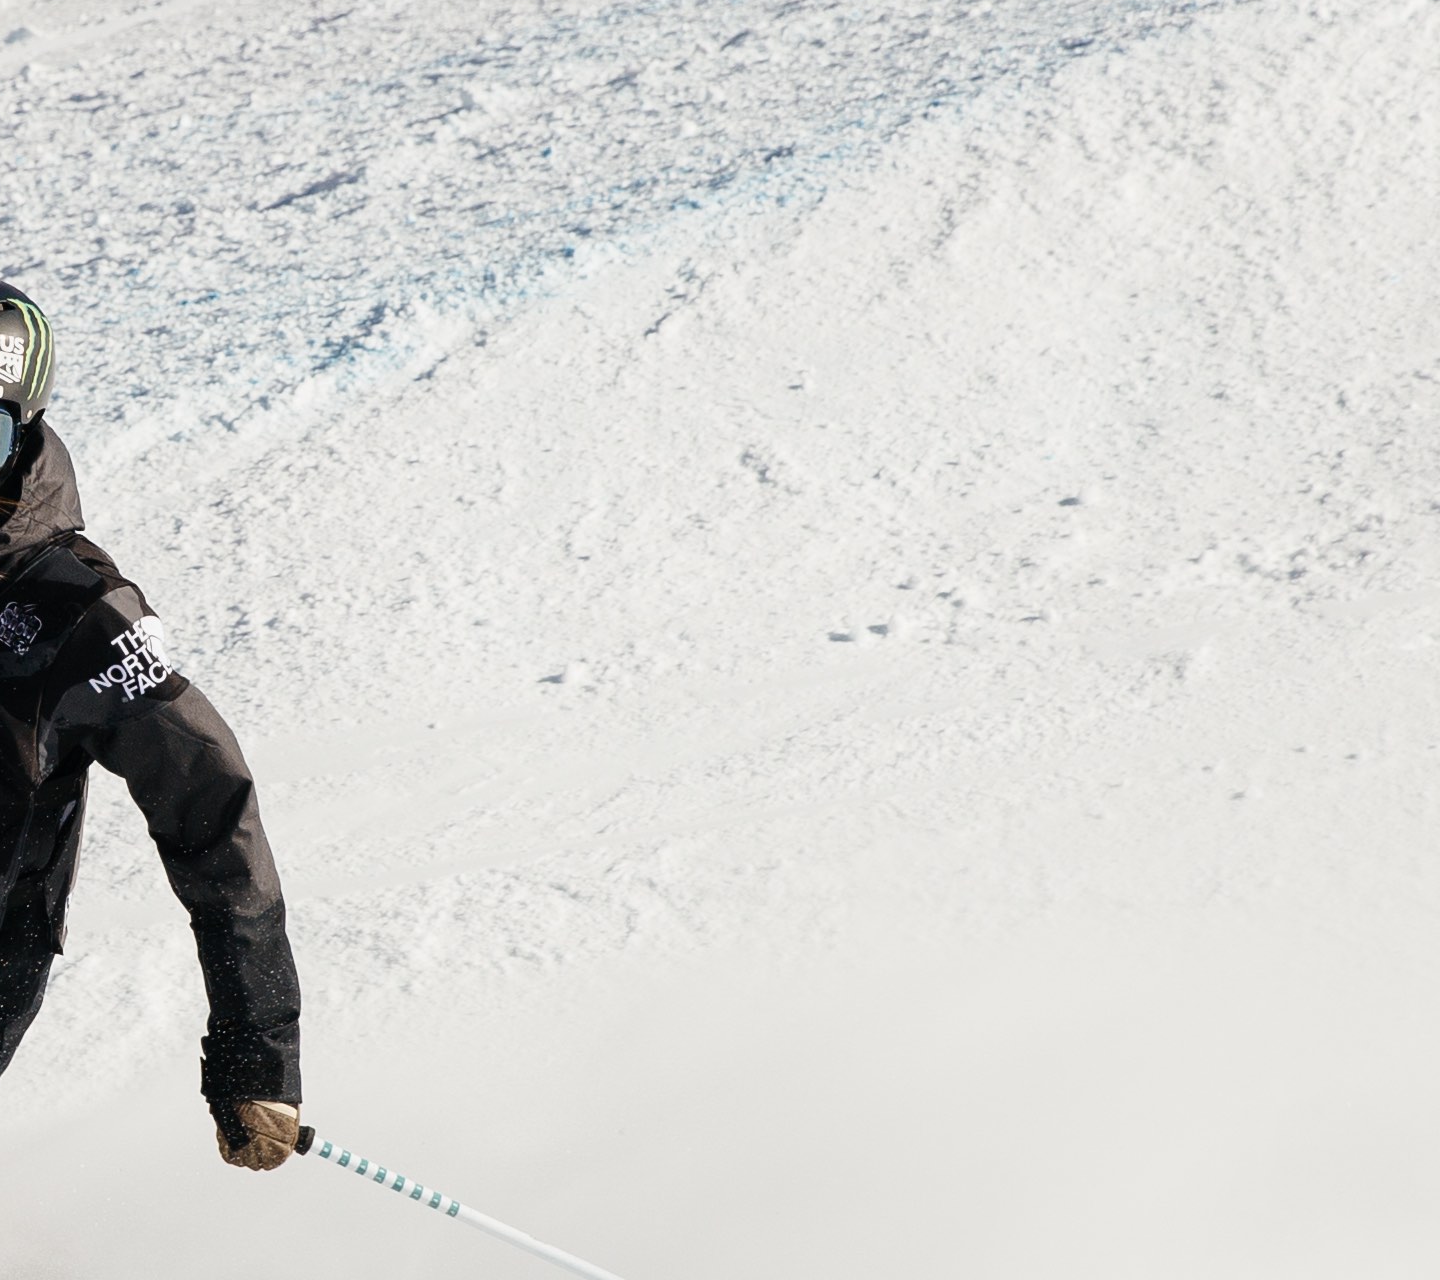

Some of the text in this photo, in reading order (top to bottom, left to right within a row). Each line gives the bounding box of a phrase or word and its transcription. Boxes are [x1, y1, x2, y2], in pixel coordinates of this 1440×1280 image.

[0, 334, 25, 354] US
[110, 620, 149, 656] THE
[88, 638, 157, 694] NORT
